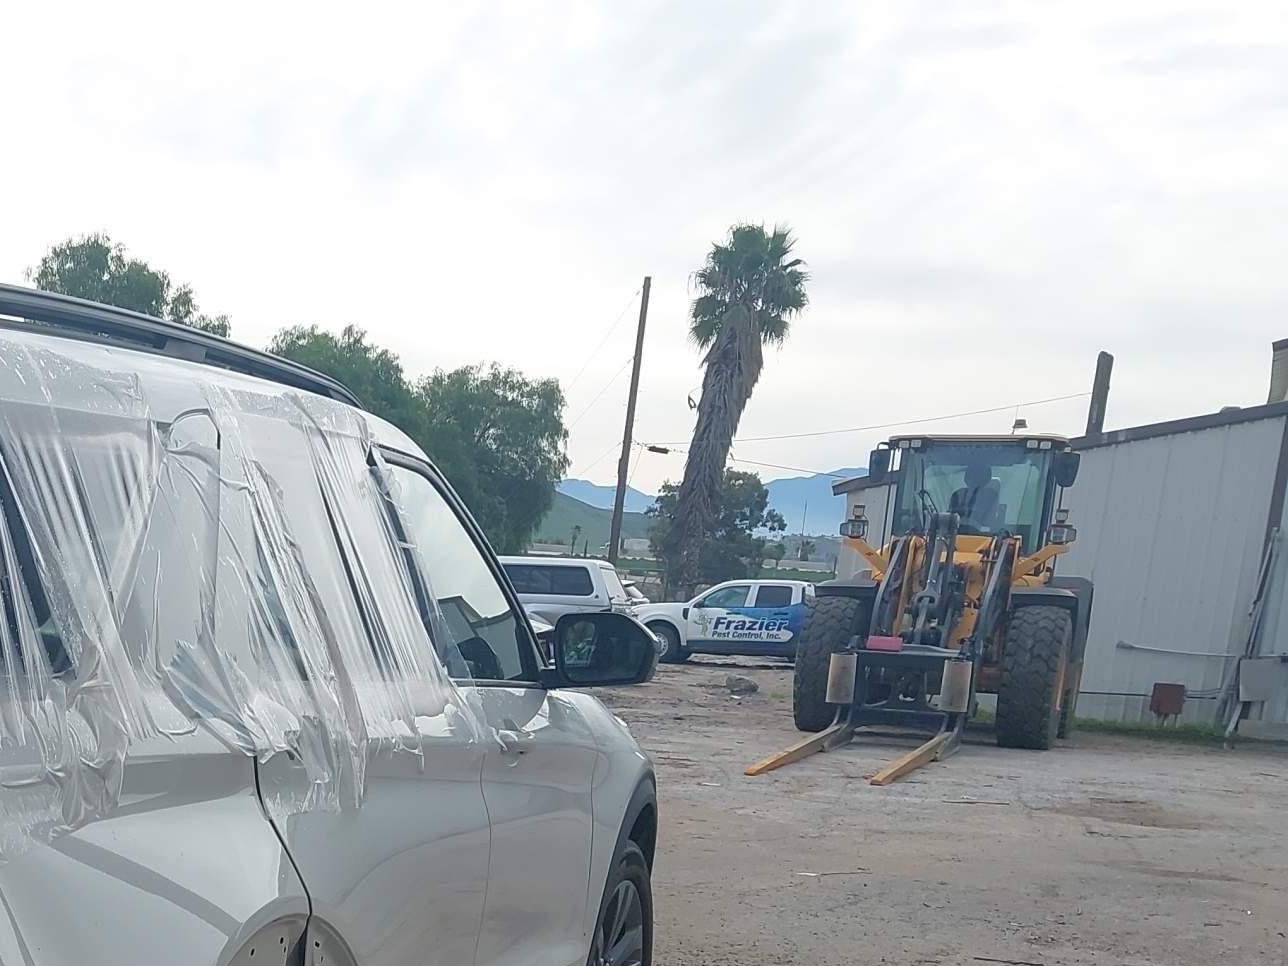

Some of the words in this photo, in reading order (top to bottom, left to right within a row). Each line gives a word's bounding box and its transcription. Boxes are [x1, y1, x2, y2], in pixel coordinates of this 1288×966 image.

[713, 616, 788, 631] Frazier
[712, 630, 730, 638] Pest
[732, 630, 764, 640] Control,
[766, 632, 782, 640] Inc.
